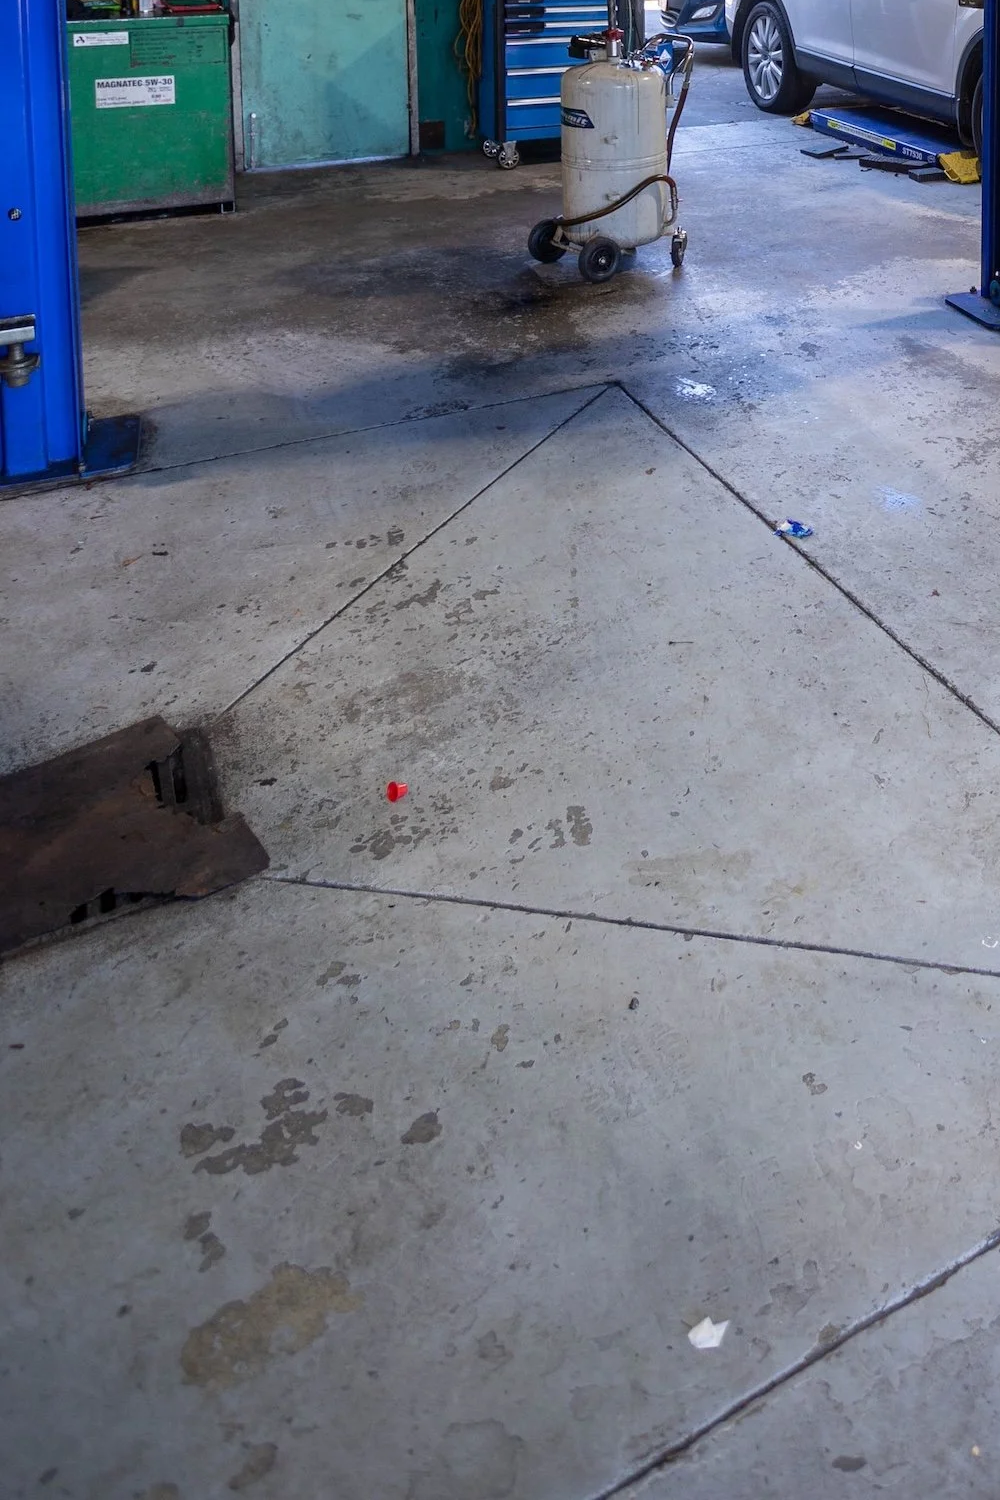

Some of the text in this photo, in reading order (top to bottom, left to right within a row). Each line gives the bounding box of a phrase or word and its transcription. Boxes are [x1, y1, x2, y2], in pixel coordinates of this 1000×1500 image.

[96, 80, 143, 89] MAGNATEC
[144, 78, 173, 87] 5W-30
[902, 147, 923, 160] ST7530
